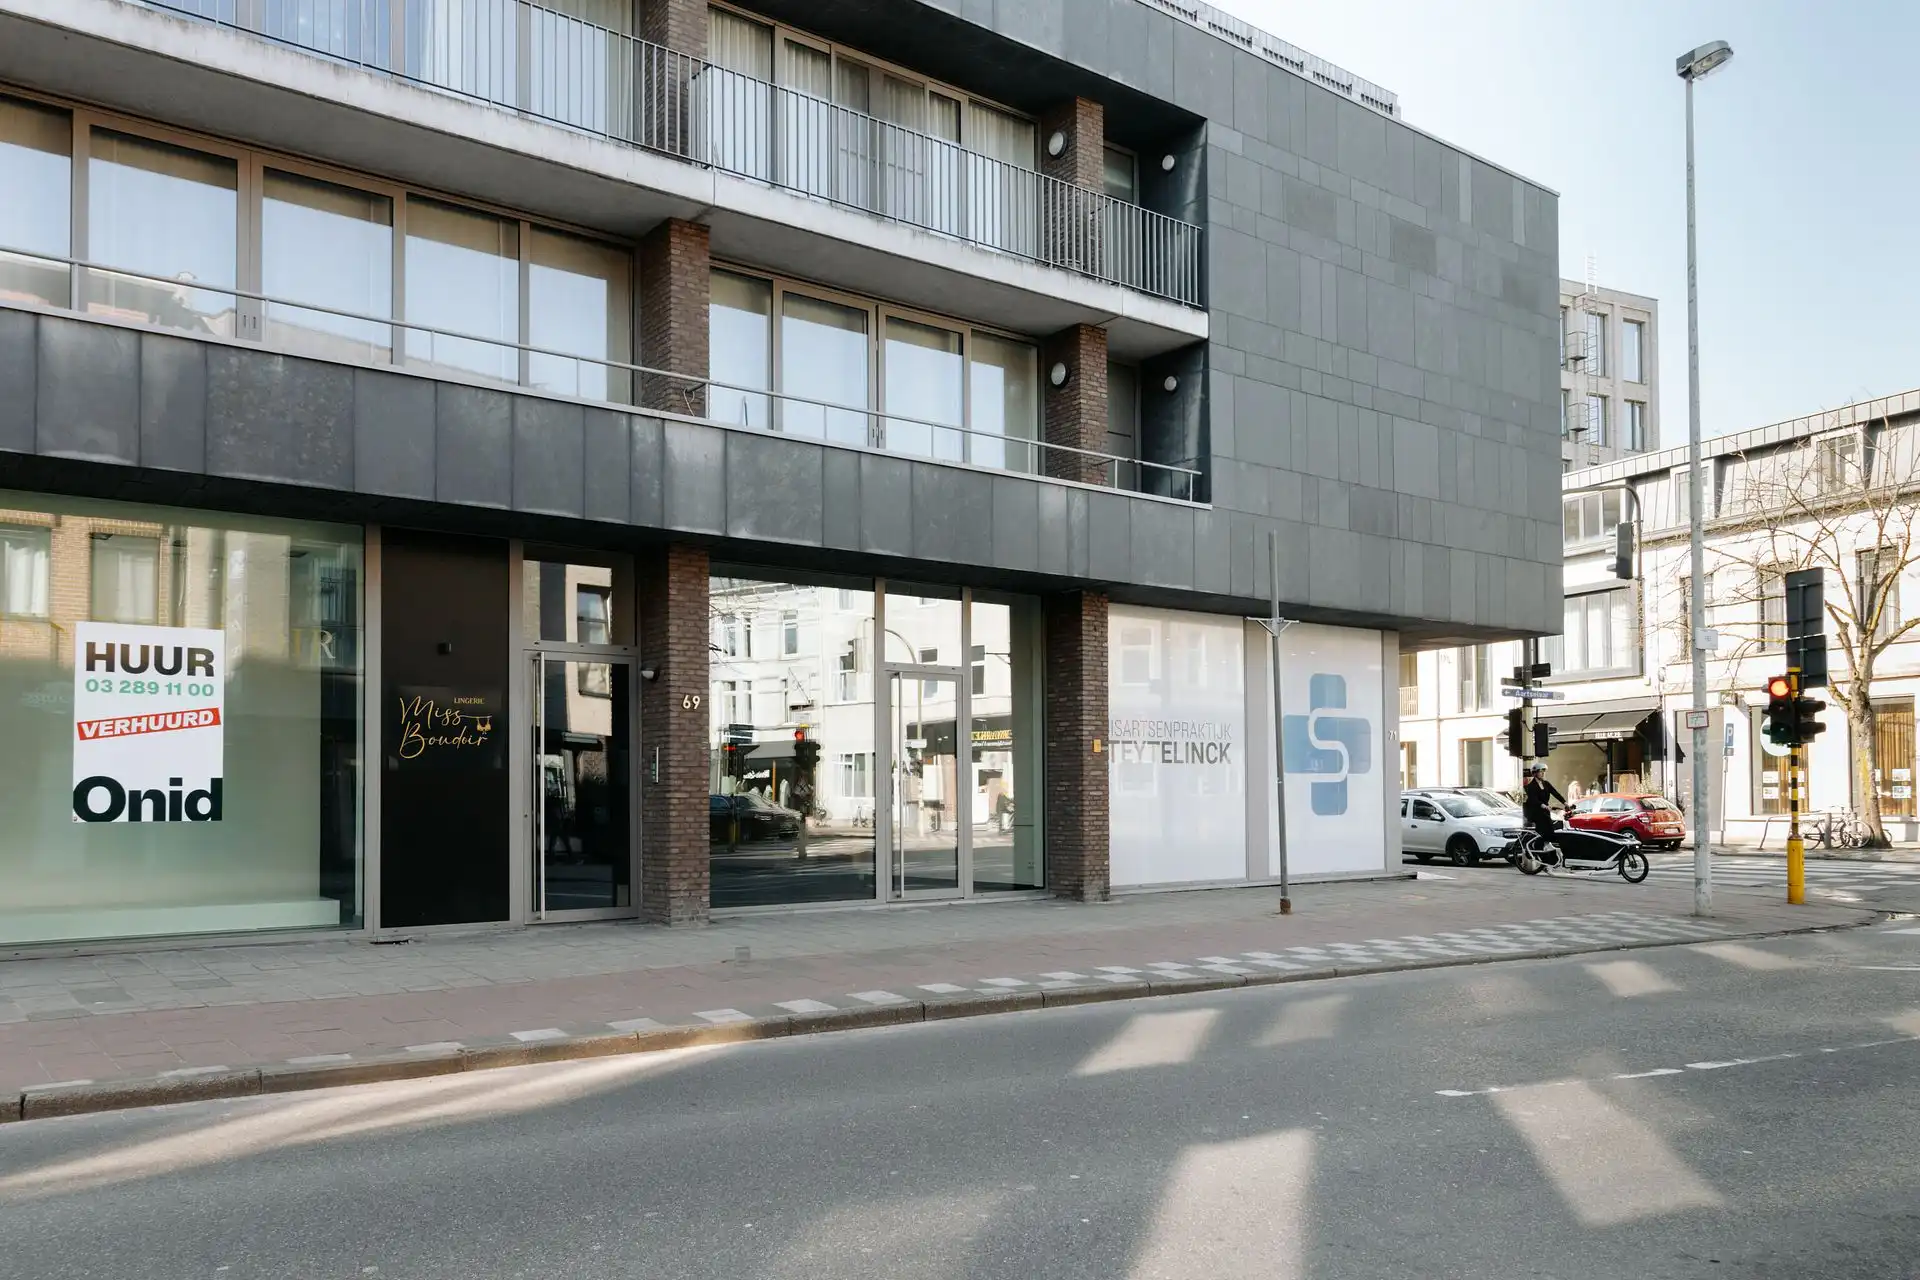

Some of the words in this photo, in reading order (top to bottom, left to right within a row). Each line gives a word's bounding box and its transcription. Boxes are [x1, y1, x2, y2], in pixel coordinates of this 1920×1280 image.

[86, 641, 215, 677] HUUR
[85, 678, 113, 693] 03
[119, 680, 159, 695] 289
[165, 682, 182, 696] 11
[188, 683, 214, 697] 00
[682, 694, 701, 710] 69
[80, 710, 214, 738] VERHUURD
[399, 695, 461, 730] Miss
[399, 721, 488, 759] Boudoir
[1107, 740, 1232, 765] TEYTELINCK
[73, 776, 223, 822] Onid
